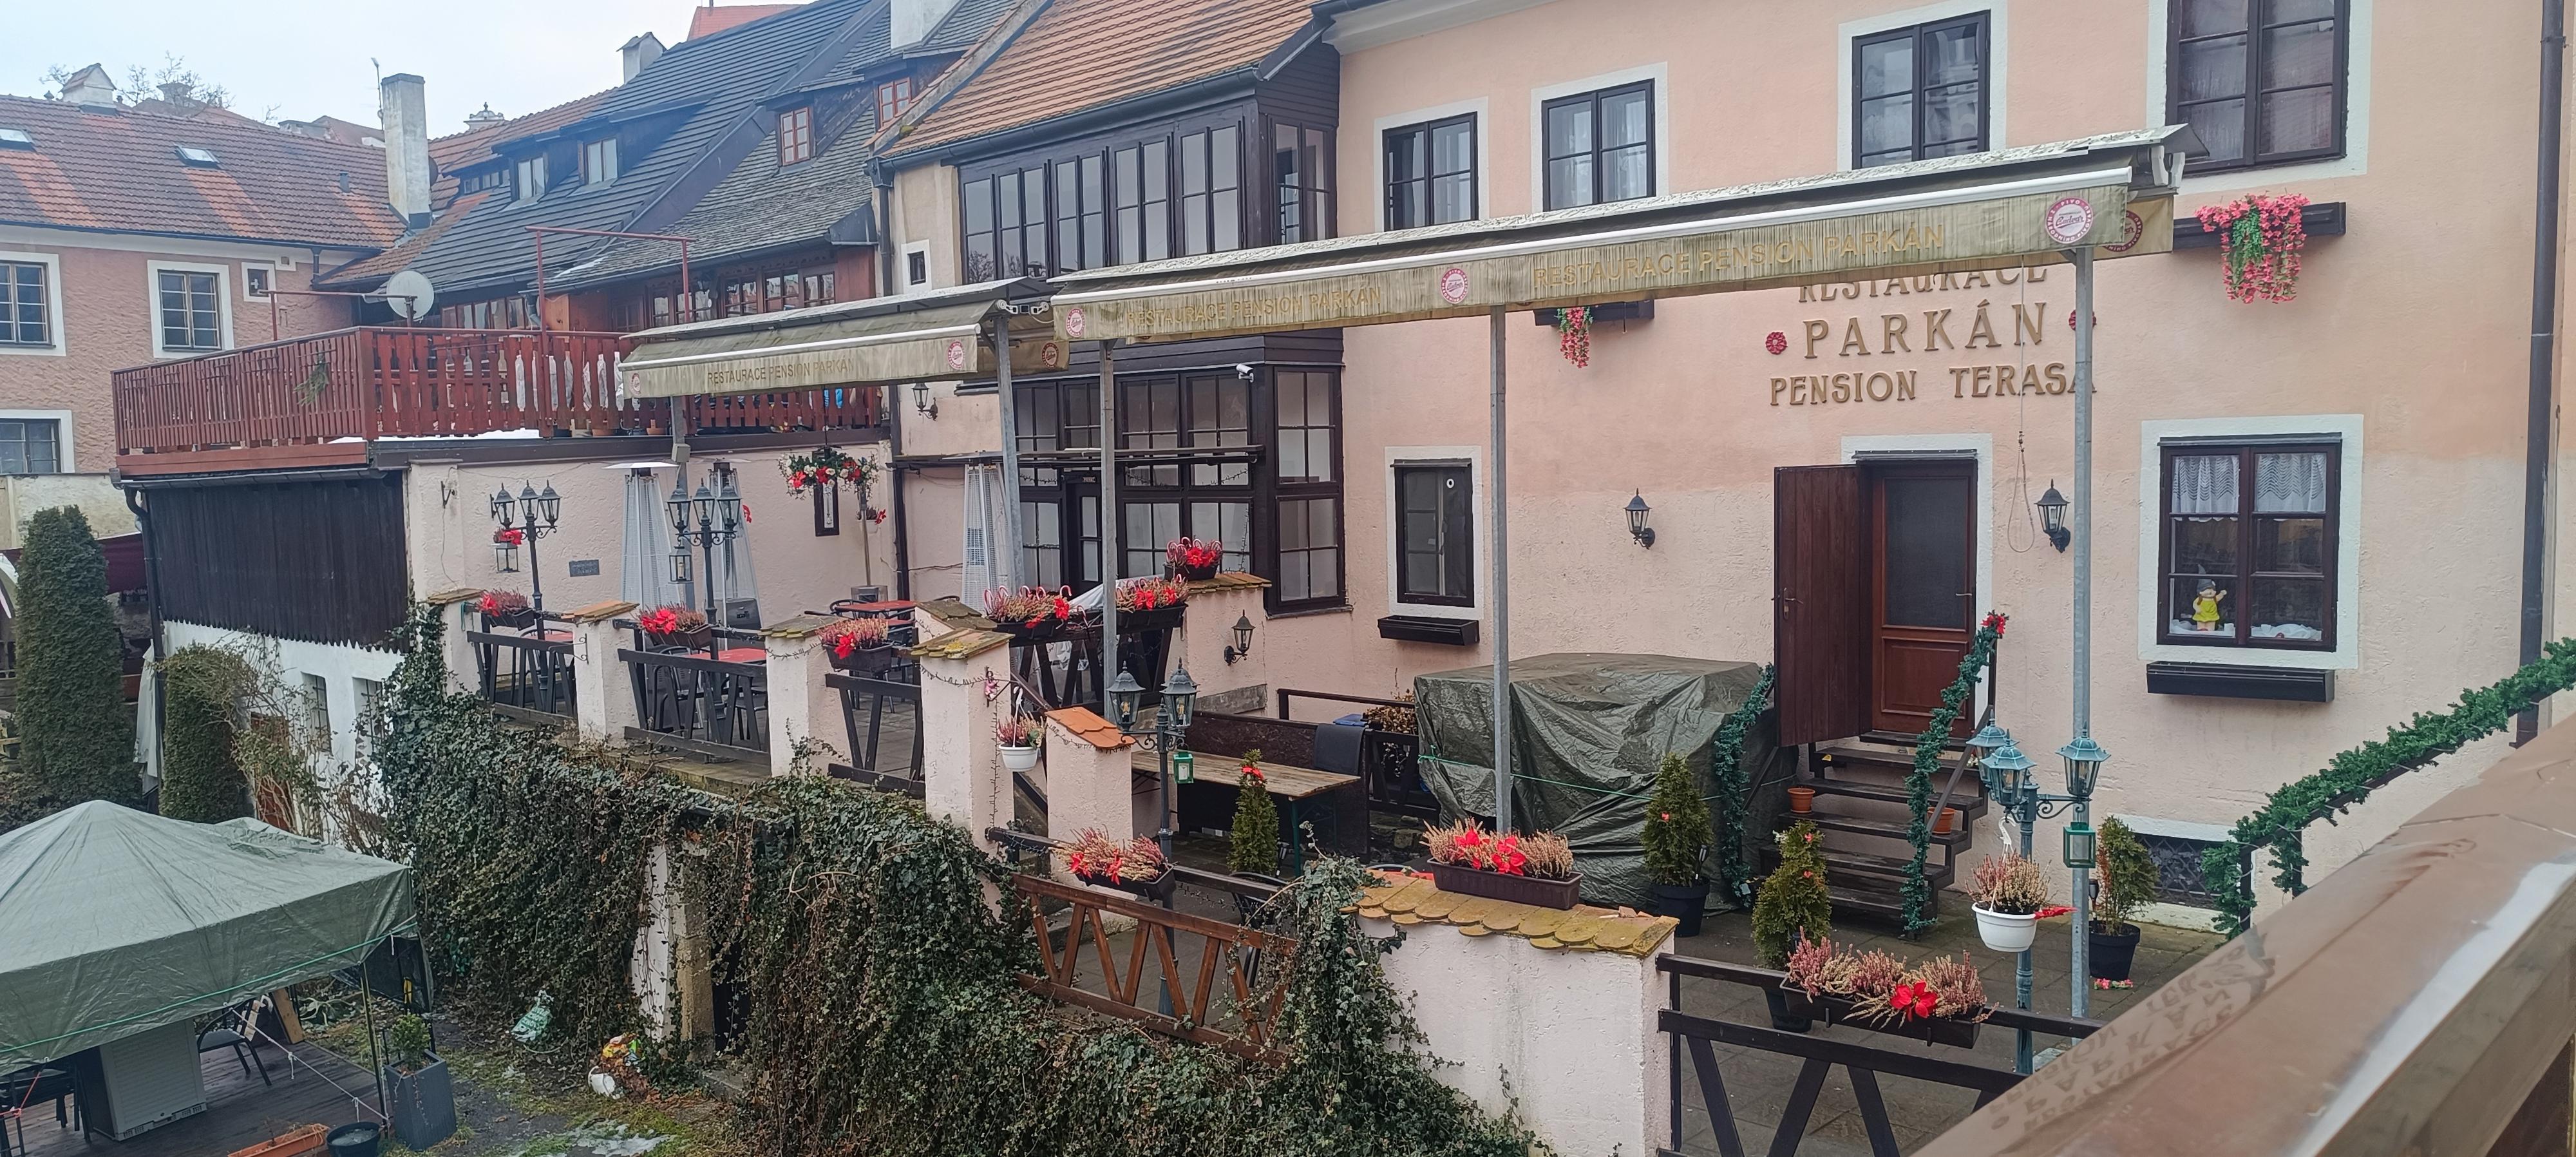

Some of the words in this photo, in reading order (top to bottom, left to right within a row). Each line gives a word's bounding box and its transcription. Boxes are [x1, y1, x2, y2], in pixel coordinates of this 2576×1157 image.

[1534, 253, 1690, 289] RESTAURACE
[1698, 240, 1814, 272] PENSION
[1823, 221, 1943, 258] PARKÁN
[1127, 303, 1227, 328] RESTAURACE
[1231, 296, 1303, 318] PENSION
[1308, 285, 1381, 311] PARKÁN
[1803, 299, 2047, 359] PARKÁN
[707, 367, 766, 385] RESTAURACE
[768, 362, 810, 379] PENSION
[813, 357, 855, 374] PARKÁN
[1770, 370, 1917, 406] PENSION
